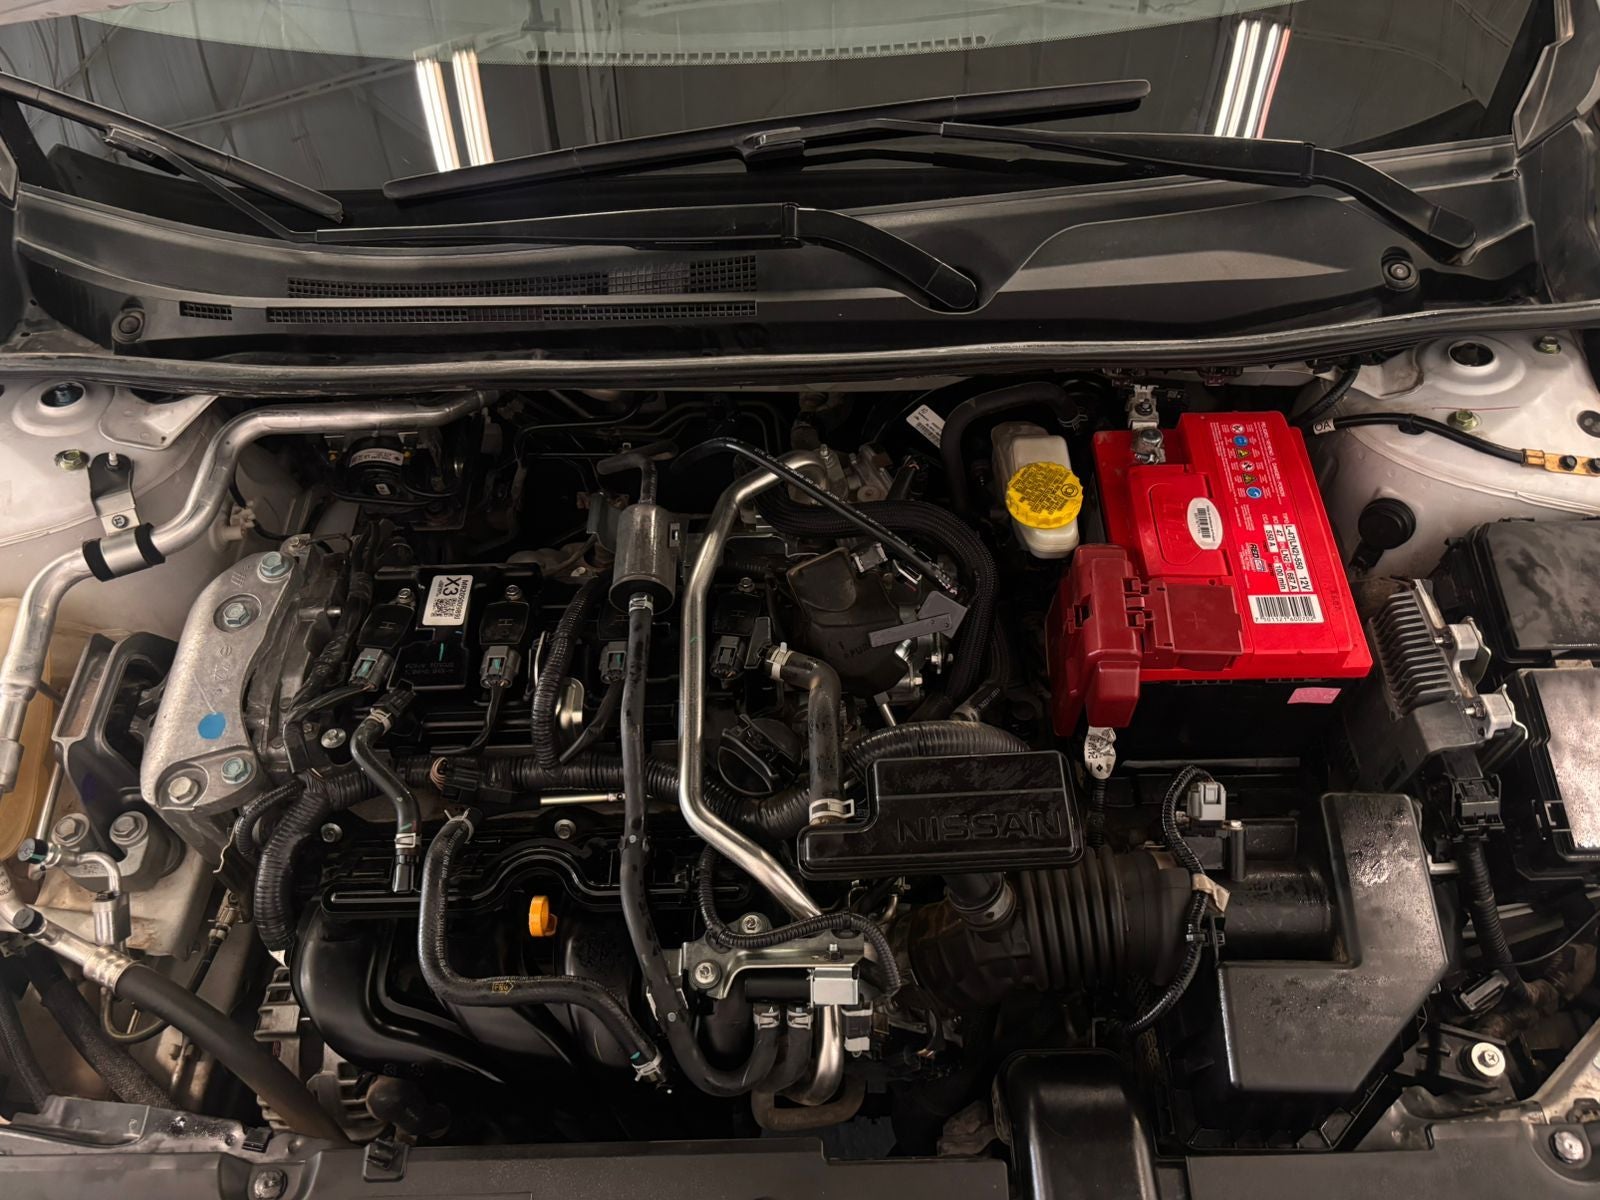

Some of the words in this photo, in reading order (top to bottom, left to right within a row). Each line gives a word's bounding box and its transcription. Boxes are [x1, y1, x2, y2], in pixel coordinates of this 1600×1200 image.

[1265, 529, 1275, 541] 550
[1276, 529, 1283, 537] 47
[1281, 550, 1290, 562] LN2
[1275, 565, 1284, 577] 100
[443, 576, 462, 596] X3
[1278, 577, 1287, 590] min
[1299, 576, 1311, 591] 12V
[897, 810, 1063, 842] NISSAN
